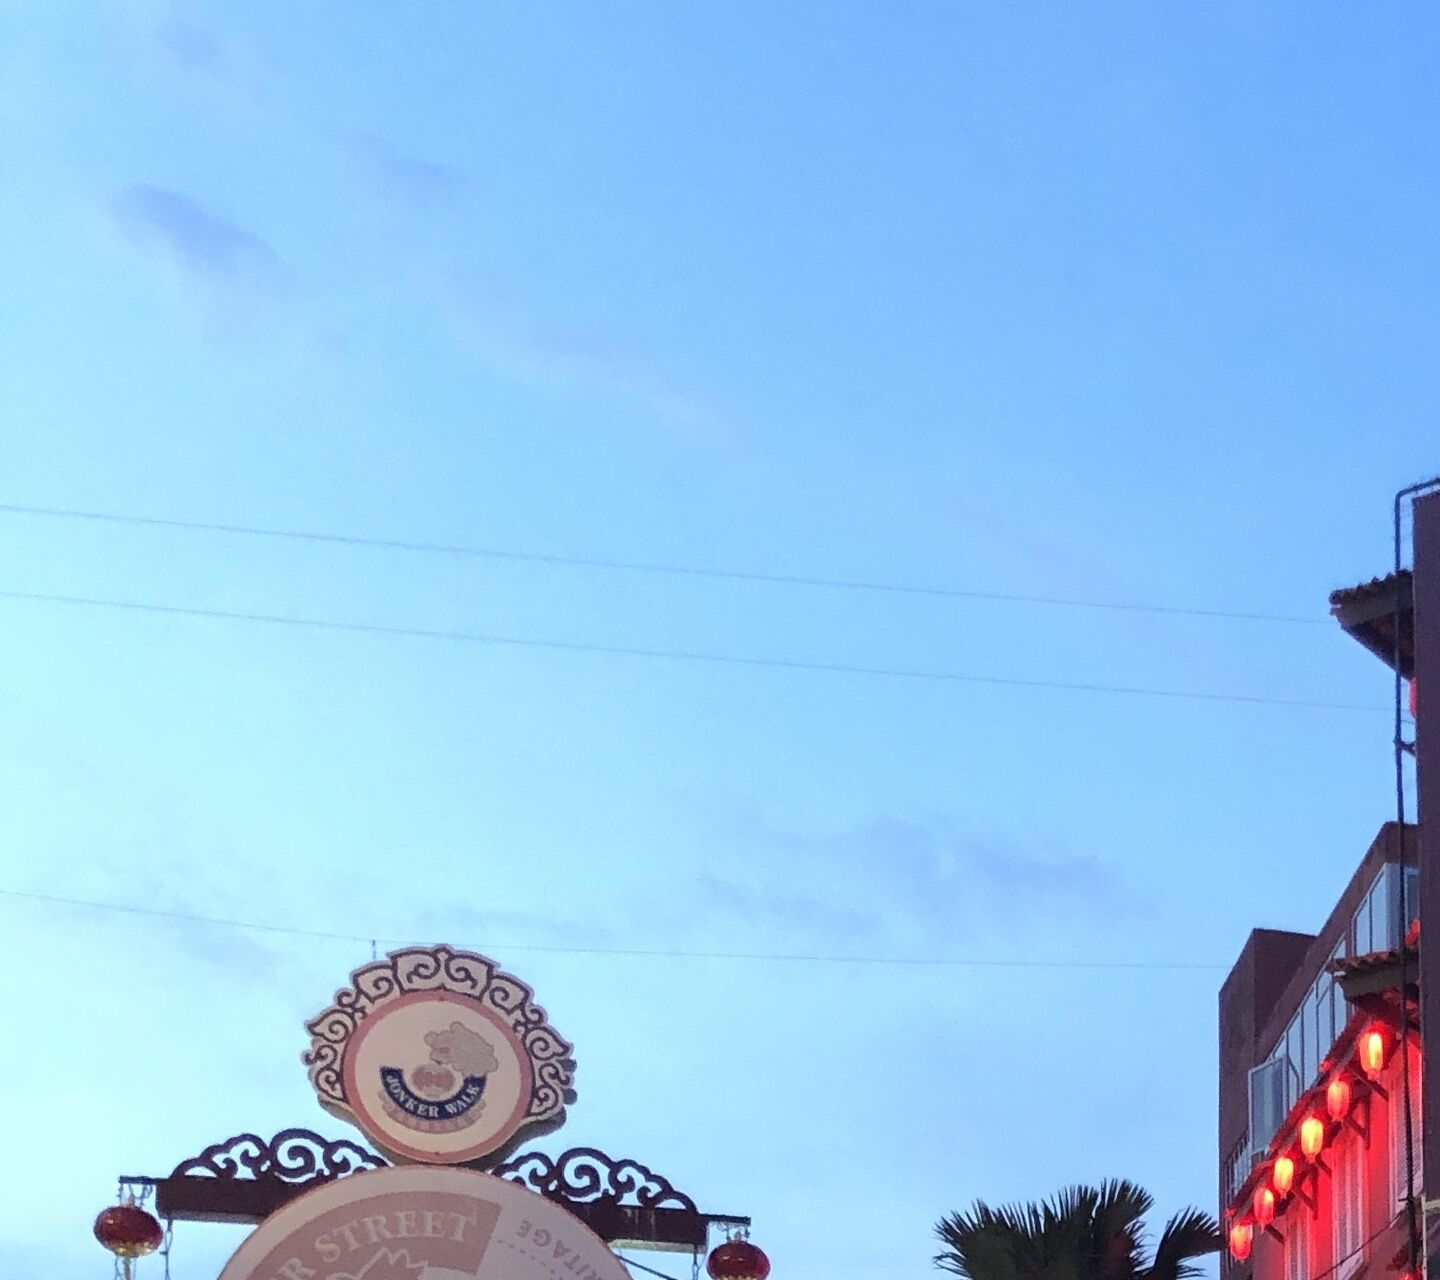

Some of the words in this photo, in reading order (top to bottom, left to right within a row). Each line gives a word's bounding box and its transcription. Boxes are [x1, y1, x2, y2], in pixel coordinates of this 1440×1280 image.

[386, 1075, 440, 1118] JONKER
[444, 1085, 480, 1115] WALK
[314, 1209, 479, 1263] STREET
